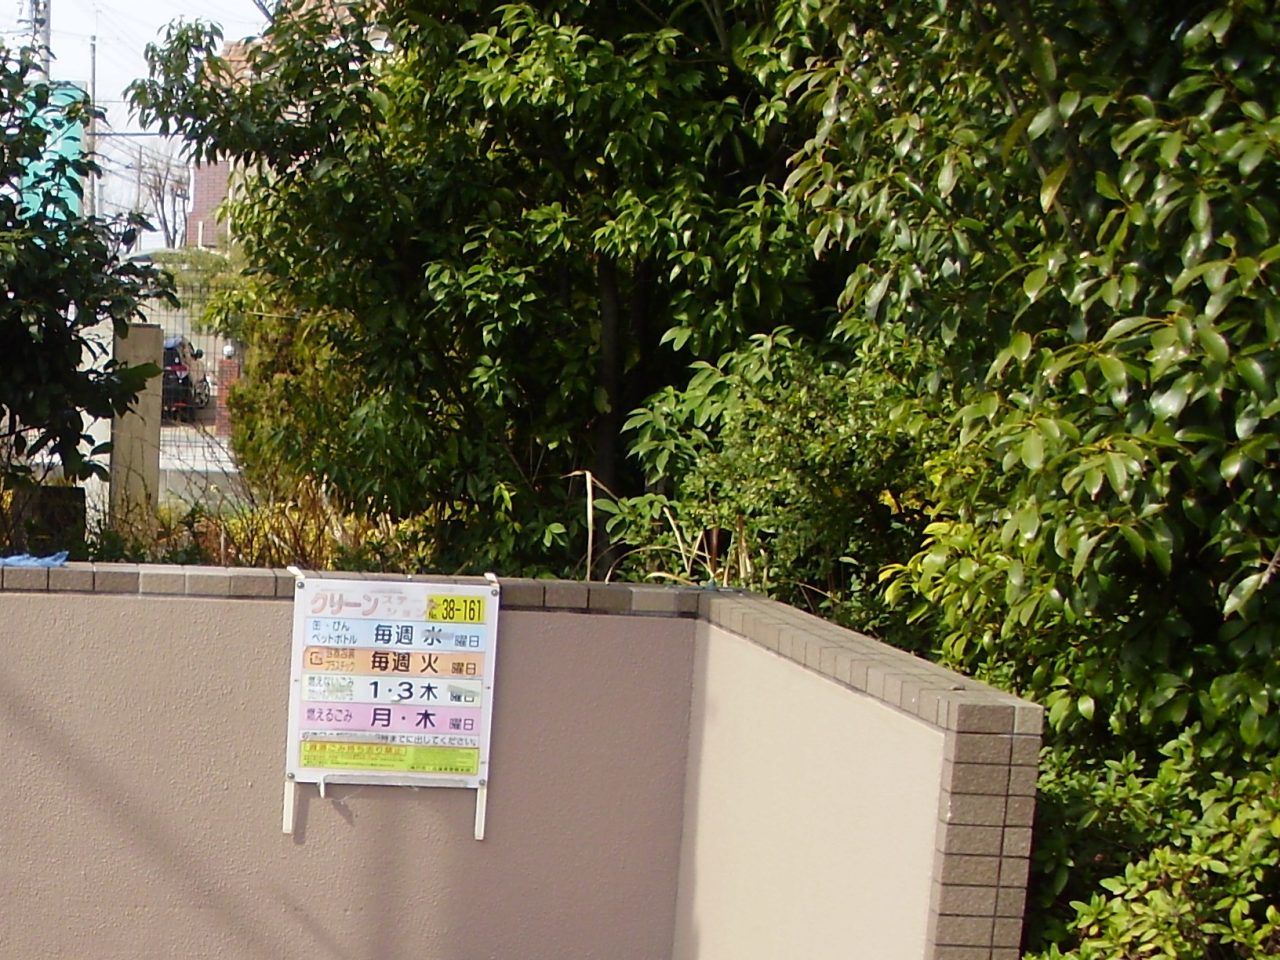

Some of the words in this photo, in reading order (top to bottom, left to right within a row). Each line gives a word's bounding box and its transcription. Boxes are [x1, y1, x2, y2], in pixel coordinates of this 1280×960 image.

[441, 598, 481, 621] 38-161
[374, 623, 414, 646] 毎週
[423, 626, 443, 646] 水
[454, 634, 480, 648] 曜日
[371, 650, 411, 673] 毎週
[420, 653, 439, 674] 火
[451, 662, 477, 676] 曜日
[419, 682, 439, 701] 木
[448, 718, 475, 731] 曜日
